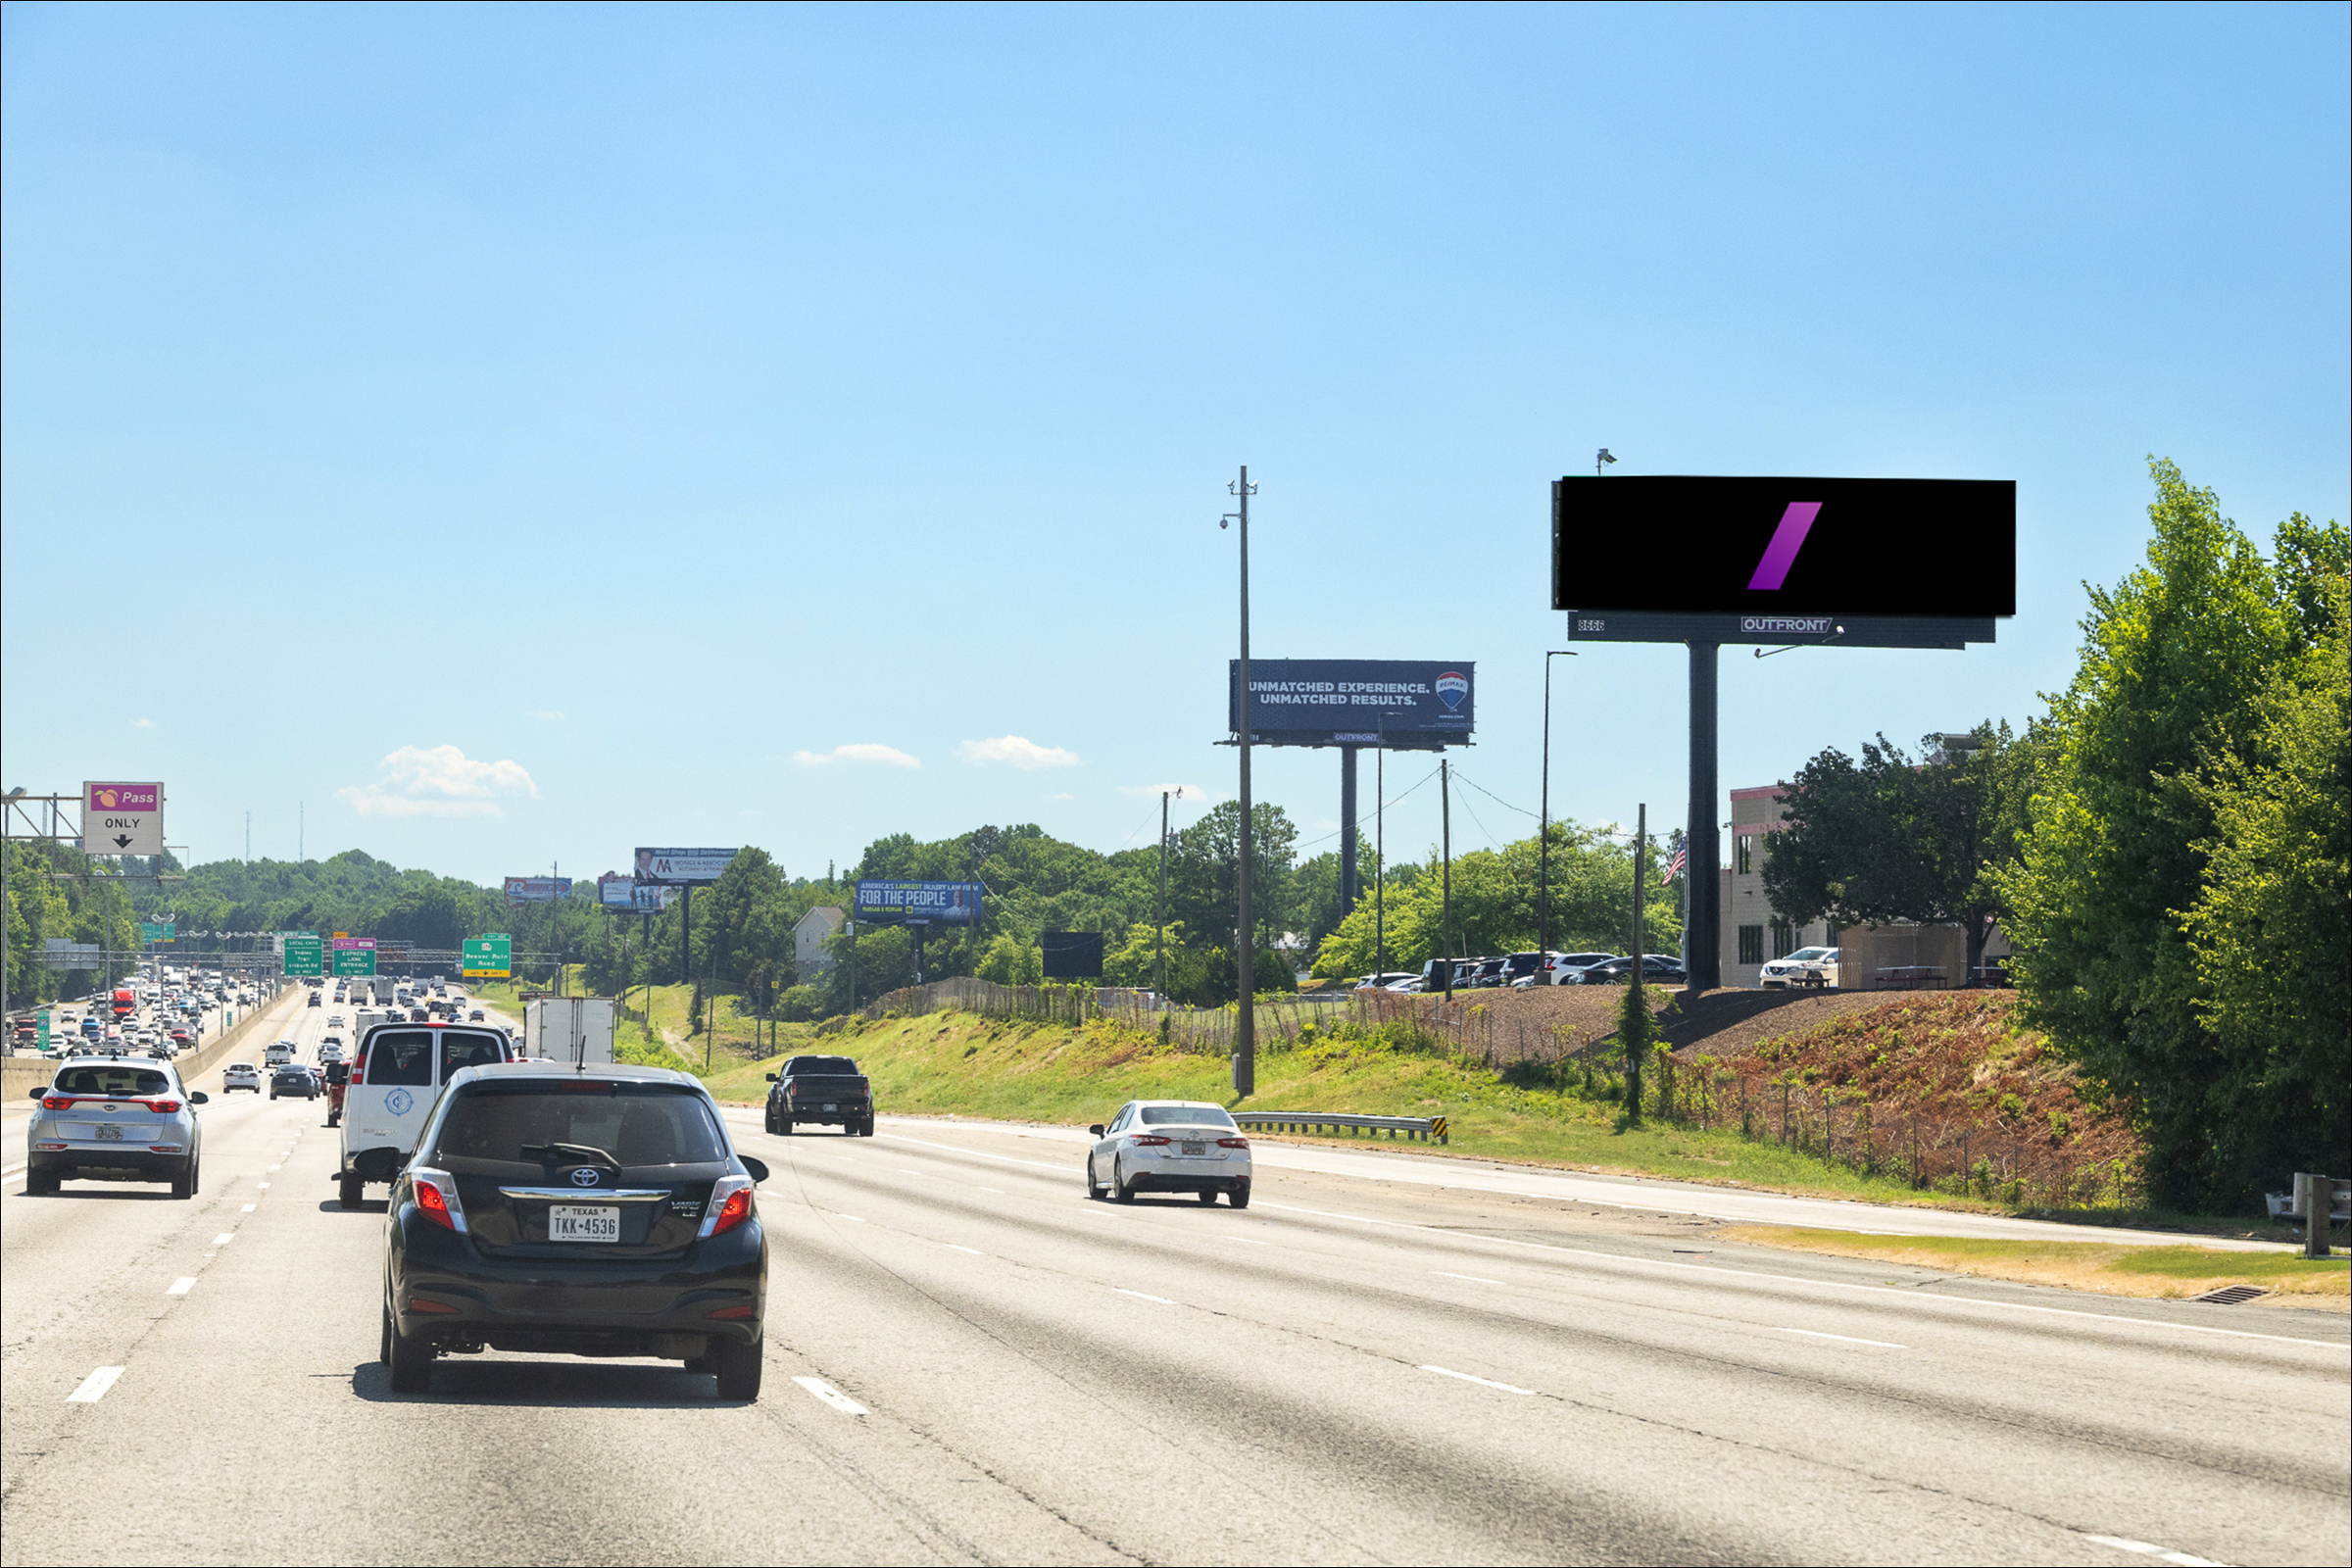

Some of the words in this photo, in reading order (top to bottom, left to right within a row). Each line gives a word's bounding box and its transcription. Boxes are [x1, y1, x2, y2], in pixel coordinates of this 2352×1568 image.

[1743, 618, 1827, 631] OUTFRONT
[1249, 682, 1335, 693] UNMATCHED
[1338, 682, 1430, 694] EXPERIENCE.
[1260, 693, 1348, 705] UNMATCHED
[1351, 694, 1417, 706] RESULTS.
[1334, 733, 1379, 742] OUTFRONT
[122, 792, 154, 803] Pass
[105, 818, 140, 828] ONLY
[859, 890, 881, 905] FOR
[883, 890, 904, 905] THE
[906, 891, 946, 906] PEOPLE
